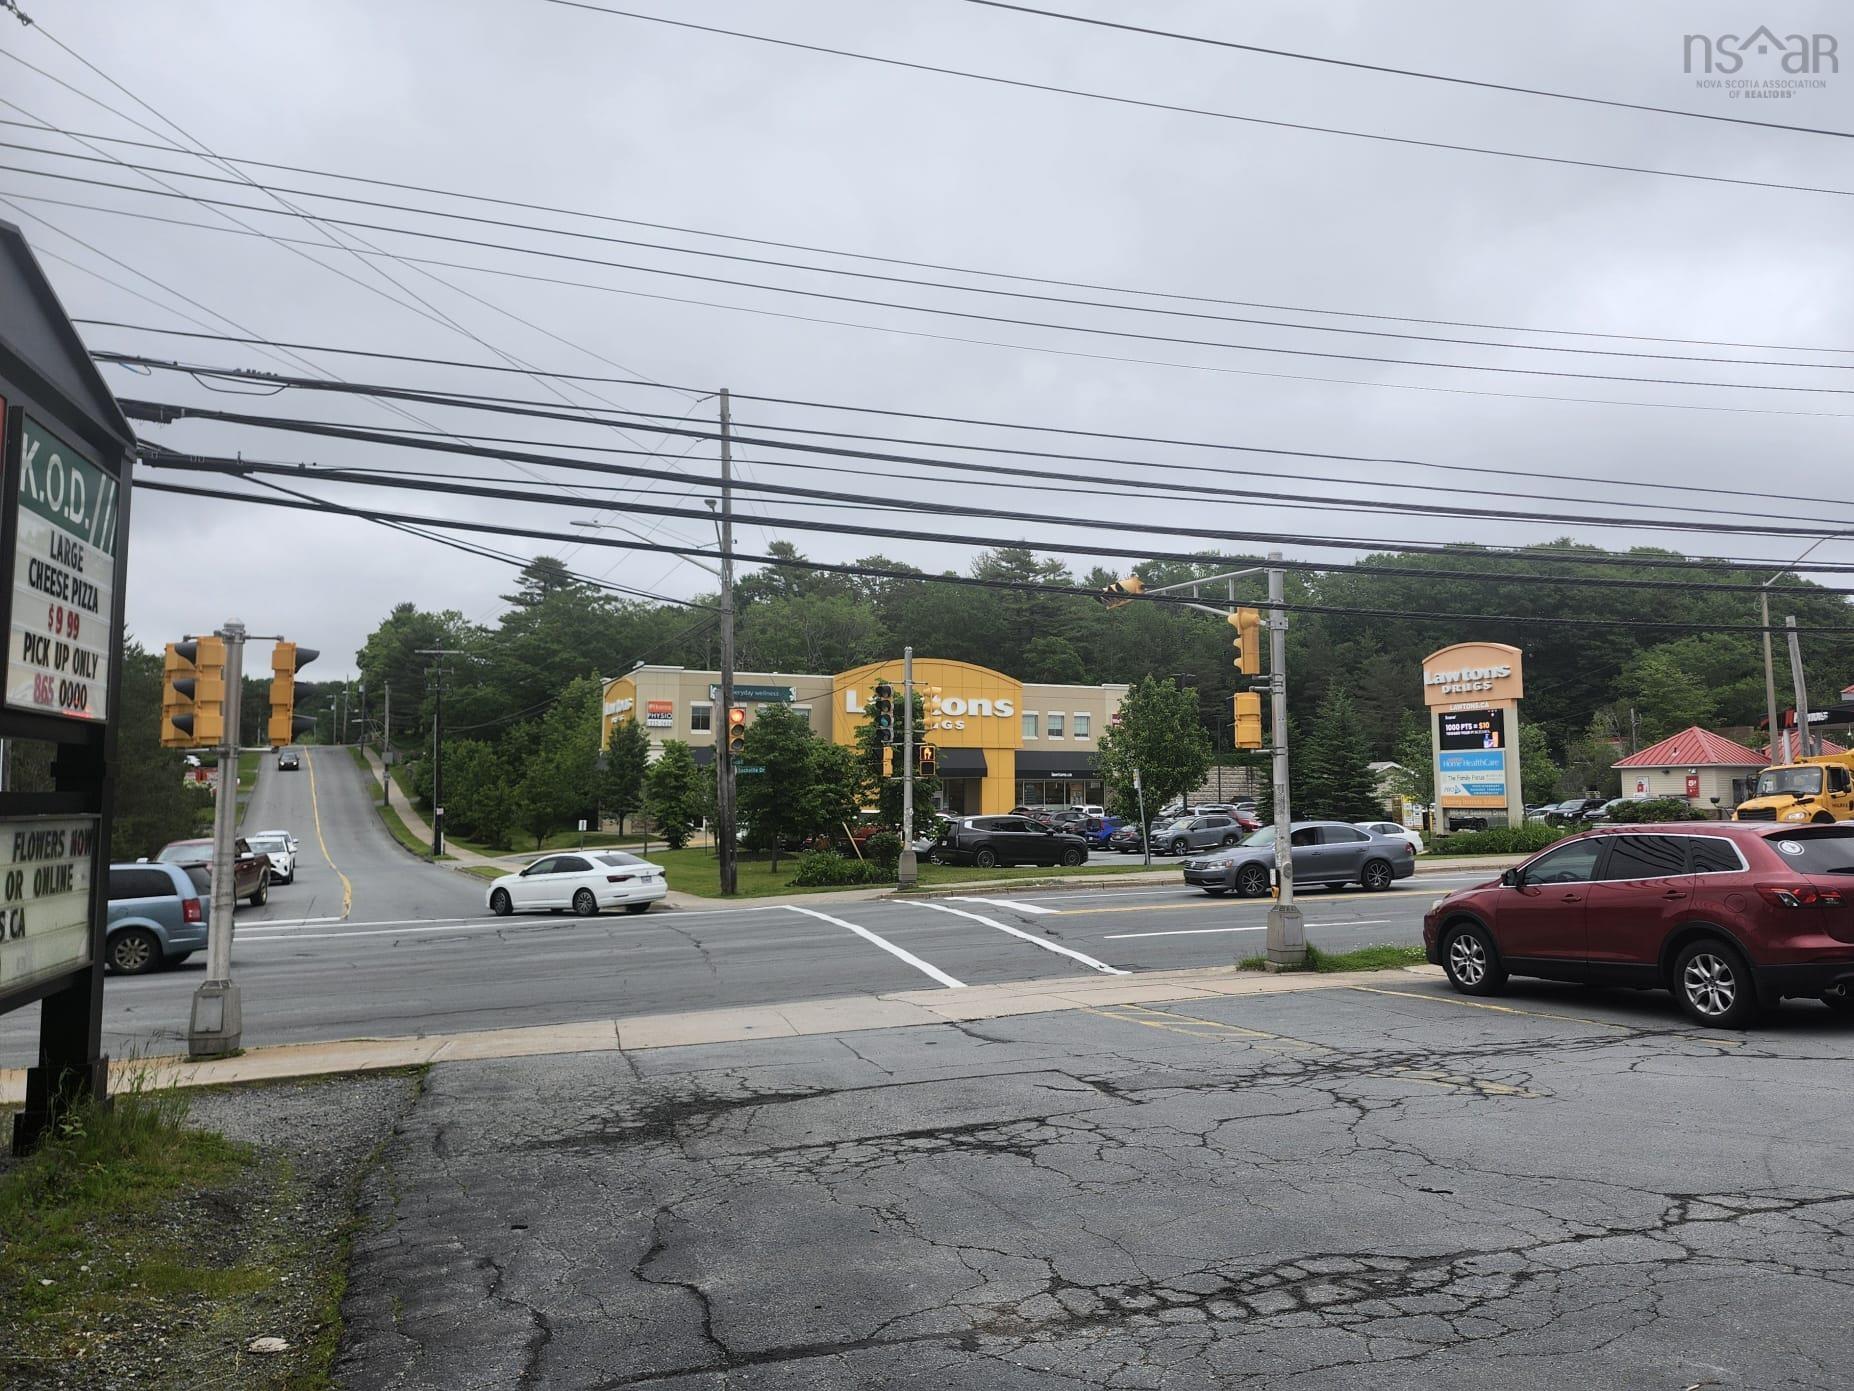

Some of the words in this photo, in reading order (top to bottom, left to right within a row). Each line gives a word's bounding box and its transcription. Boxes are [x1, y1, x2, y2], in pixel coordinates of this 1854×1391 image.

[50, 529, 84, 573] LARGE
[28, 558, 69, 601] CHEESE
[71, 584, 99, 614] PIZZA
[23, 631, 50, 668] PICK
[54, 639, 70, 672] UP
[73, 647, 99, 680] ONLY
[1424, 664, 1512, 685] Lawtons
[1441, 680, 1492, 695] DRUGS
[846, 690, 1015, 718] Lons
[1445, 723, 1460, 731] 1000
[1461, 722, 1473, 731] PTS
[1479, 721, 1490, 730] $10
[12, 829, 66, 863] FLOWERS
[70, 828, 94, 857] NOW
[5, 869, 24, 902] OR
[33, 863, 74, 898] ONLINE
